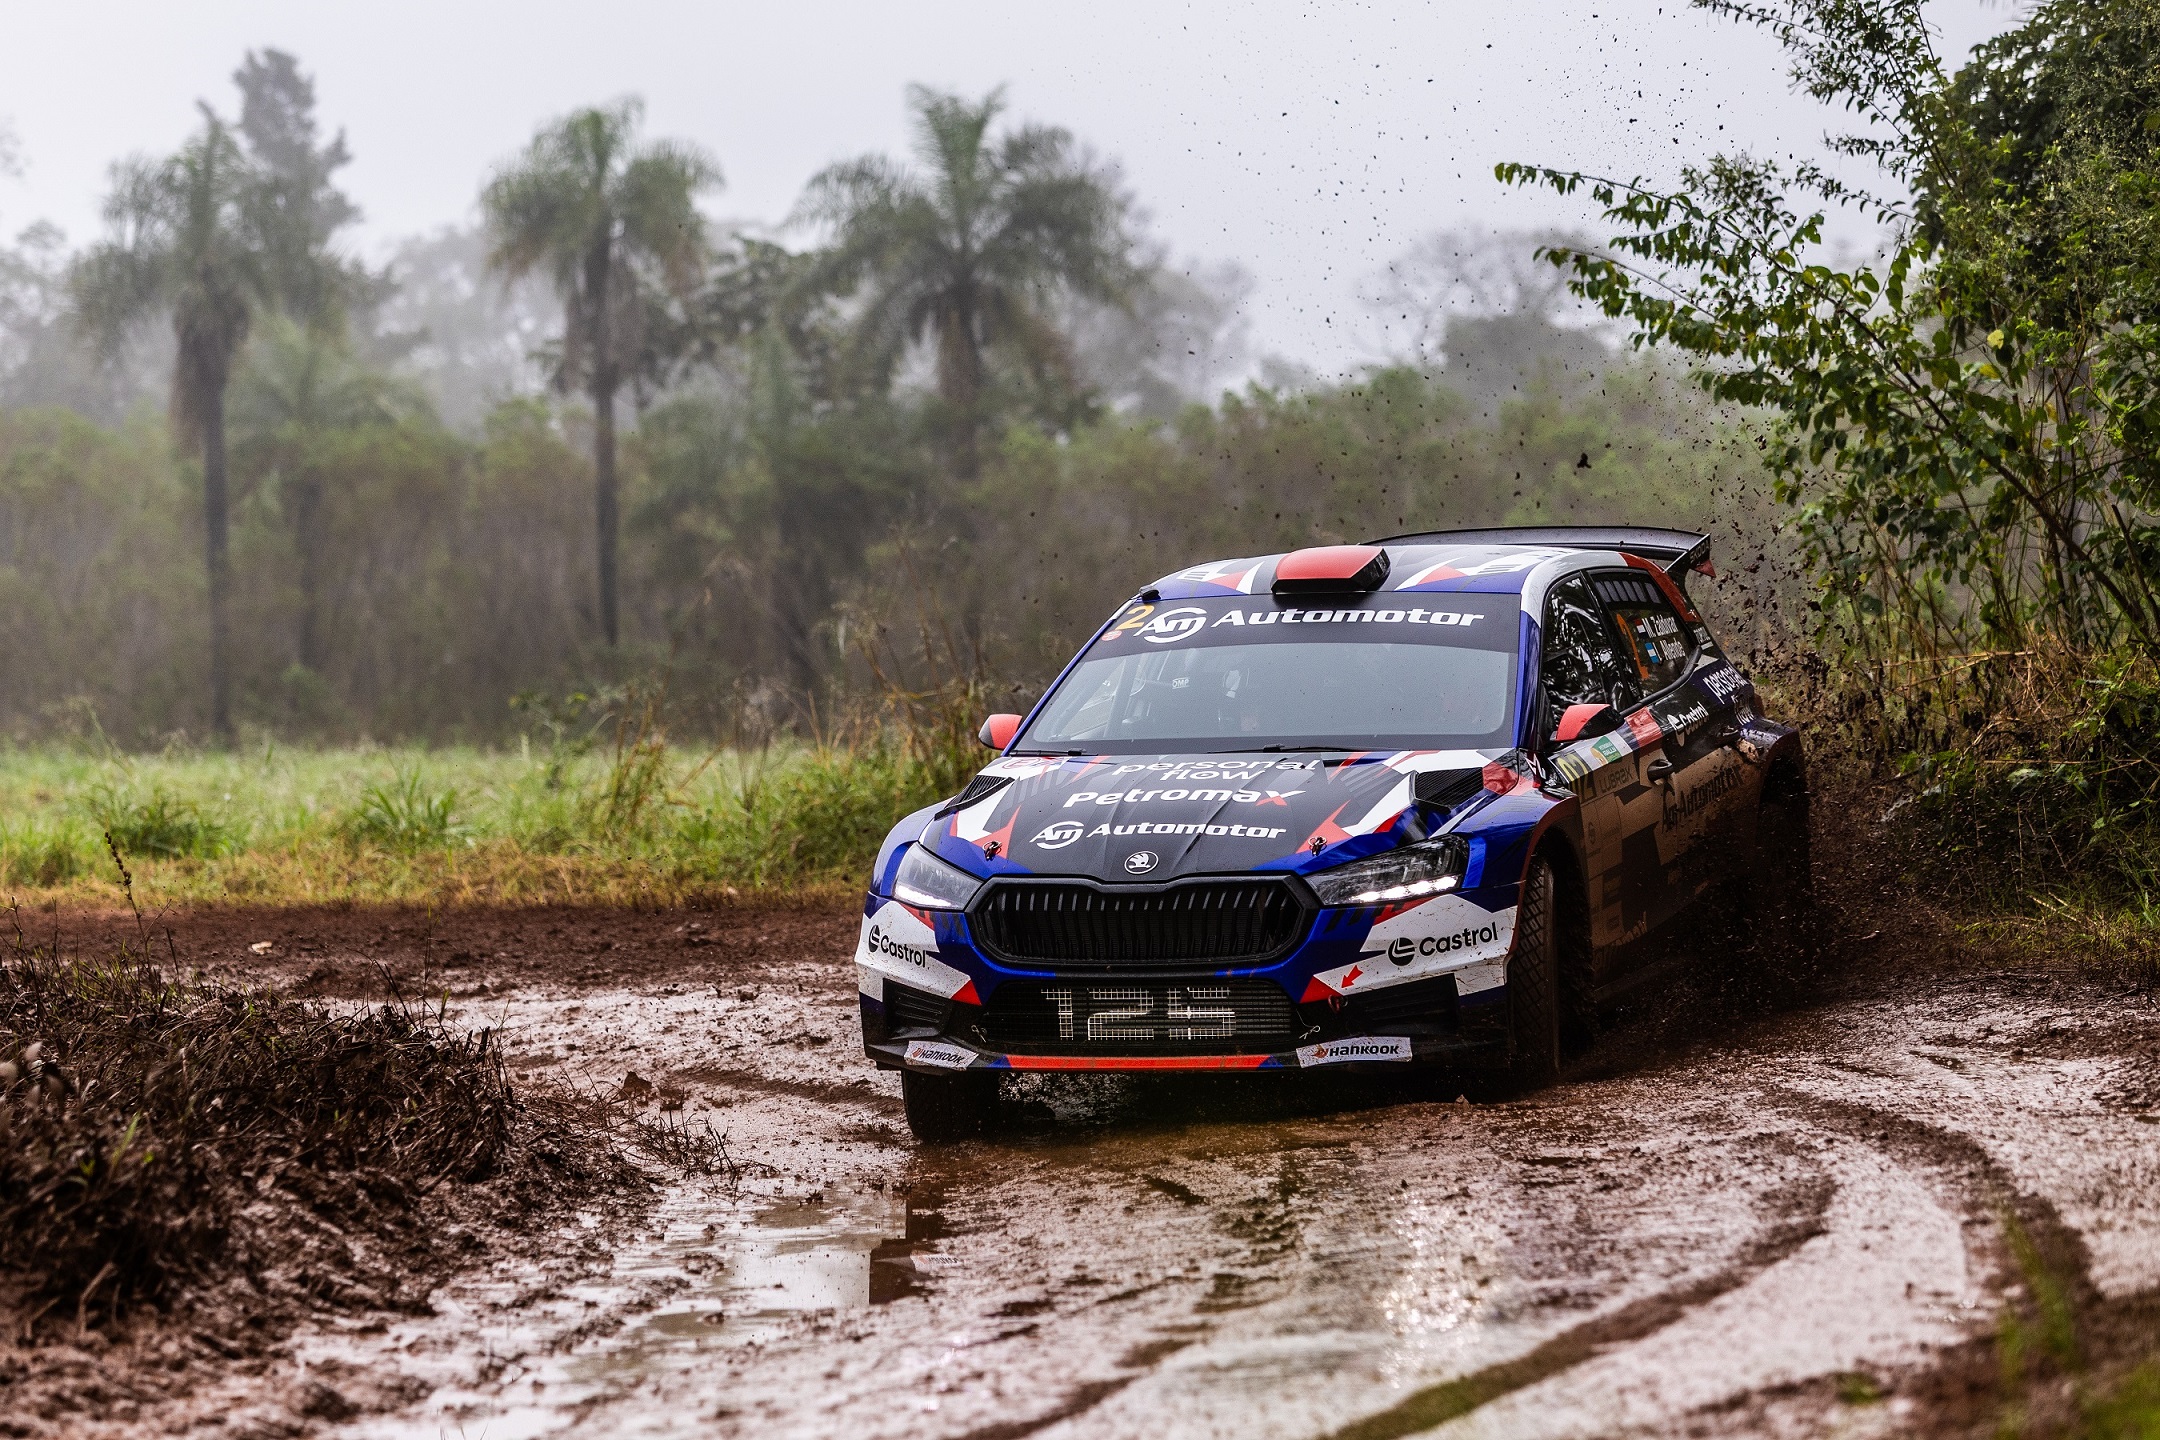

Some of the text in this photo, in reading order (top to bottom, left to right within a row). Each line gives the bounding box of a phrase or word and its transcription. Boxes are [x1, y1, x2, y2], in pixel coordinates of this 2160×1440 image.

[1114, 604, 1155, 631] 2
[1211, 608, 1485, 627] Automotor
[1111, 759, 1321, 776] personal
[1159, 769, 1266, 781] flow
[1063, 788, 1307, 808] Petromax
[1086, 822, 1287, 839] Automotor
[1419, 922, 1498, 957] Castrol
[880, 934, 926, 968] Castrol
